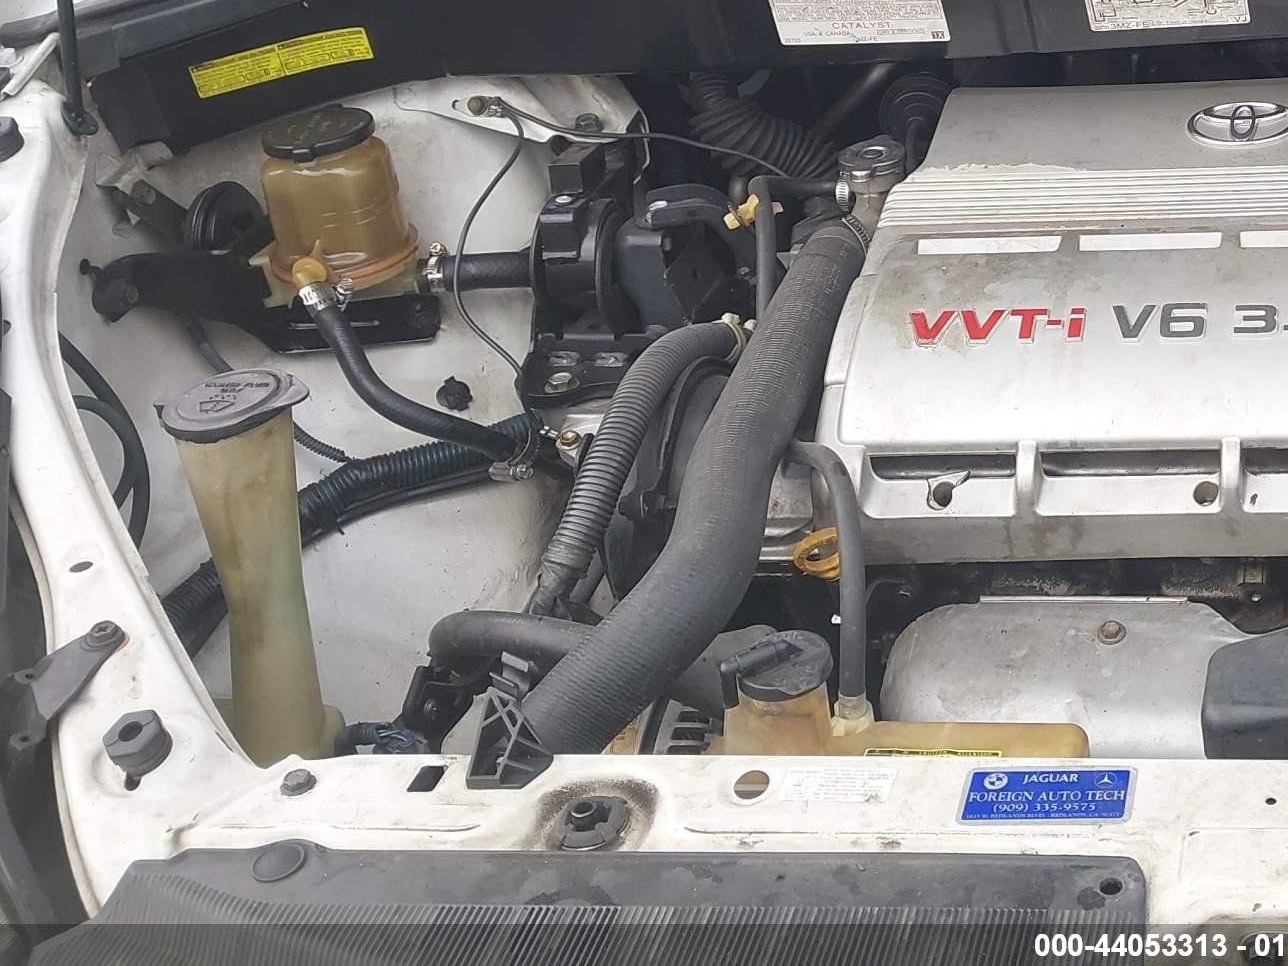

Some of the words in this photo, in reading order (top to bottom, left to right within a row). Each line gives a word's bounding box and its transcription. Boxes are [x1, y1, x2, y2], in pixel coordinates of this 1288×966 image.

[831, 21, 892, 30] CATALYST
[908, 307, 1089, 349] VVT-i
[1110, 303, 1209, 342] V6
[1022, 773, 1080, 785] JAGUAR
[967, 790, 1035, 803] FOREIGN
[1038, 790, 1082, 802] AUTO
[1086, 790, 1126, 801] TECH
[992, 802, 1030, 813] (909)
[1032, 802, 1097, 812] 335-9575
